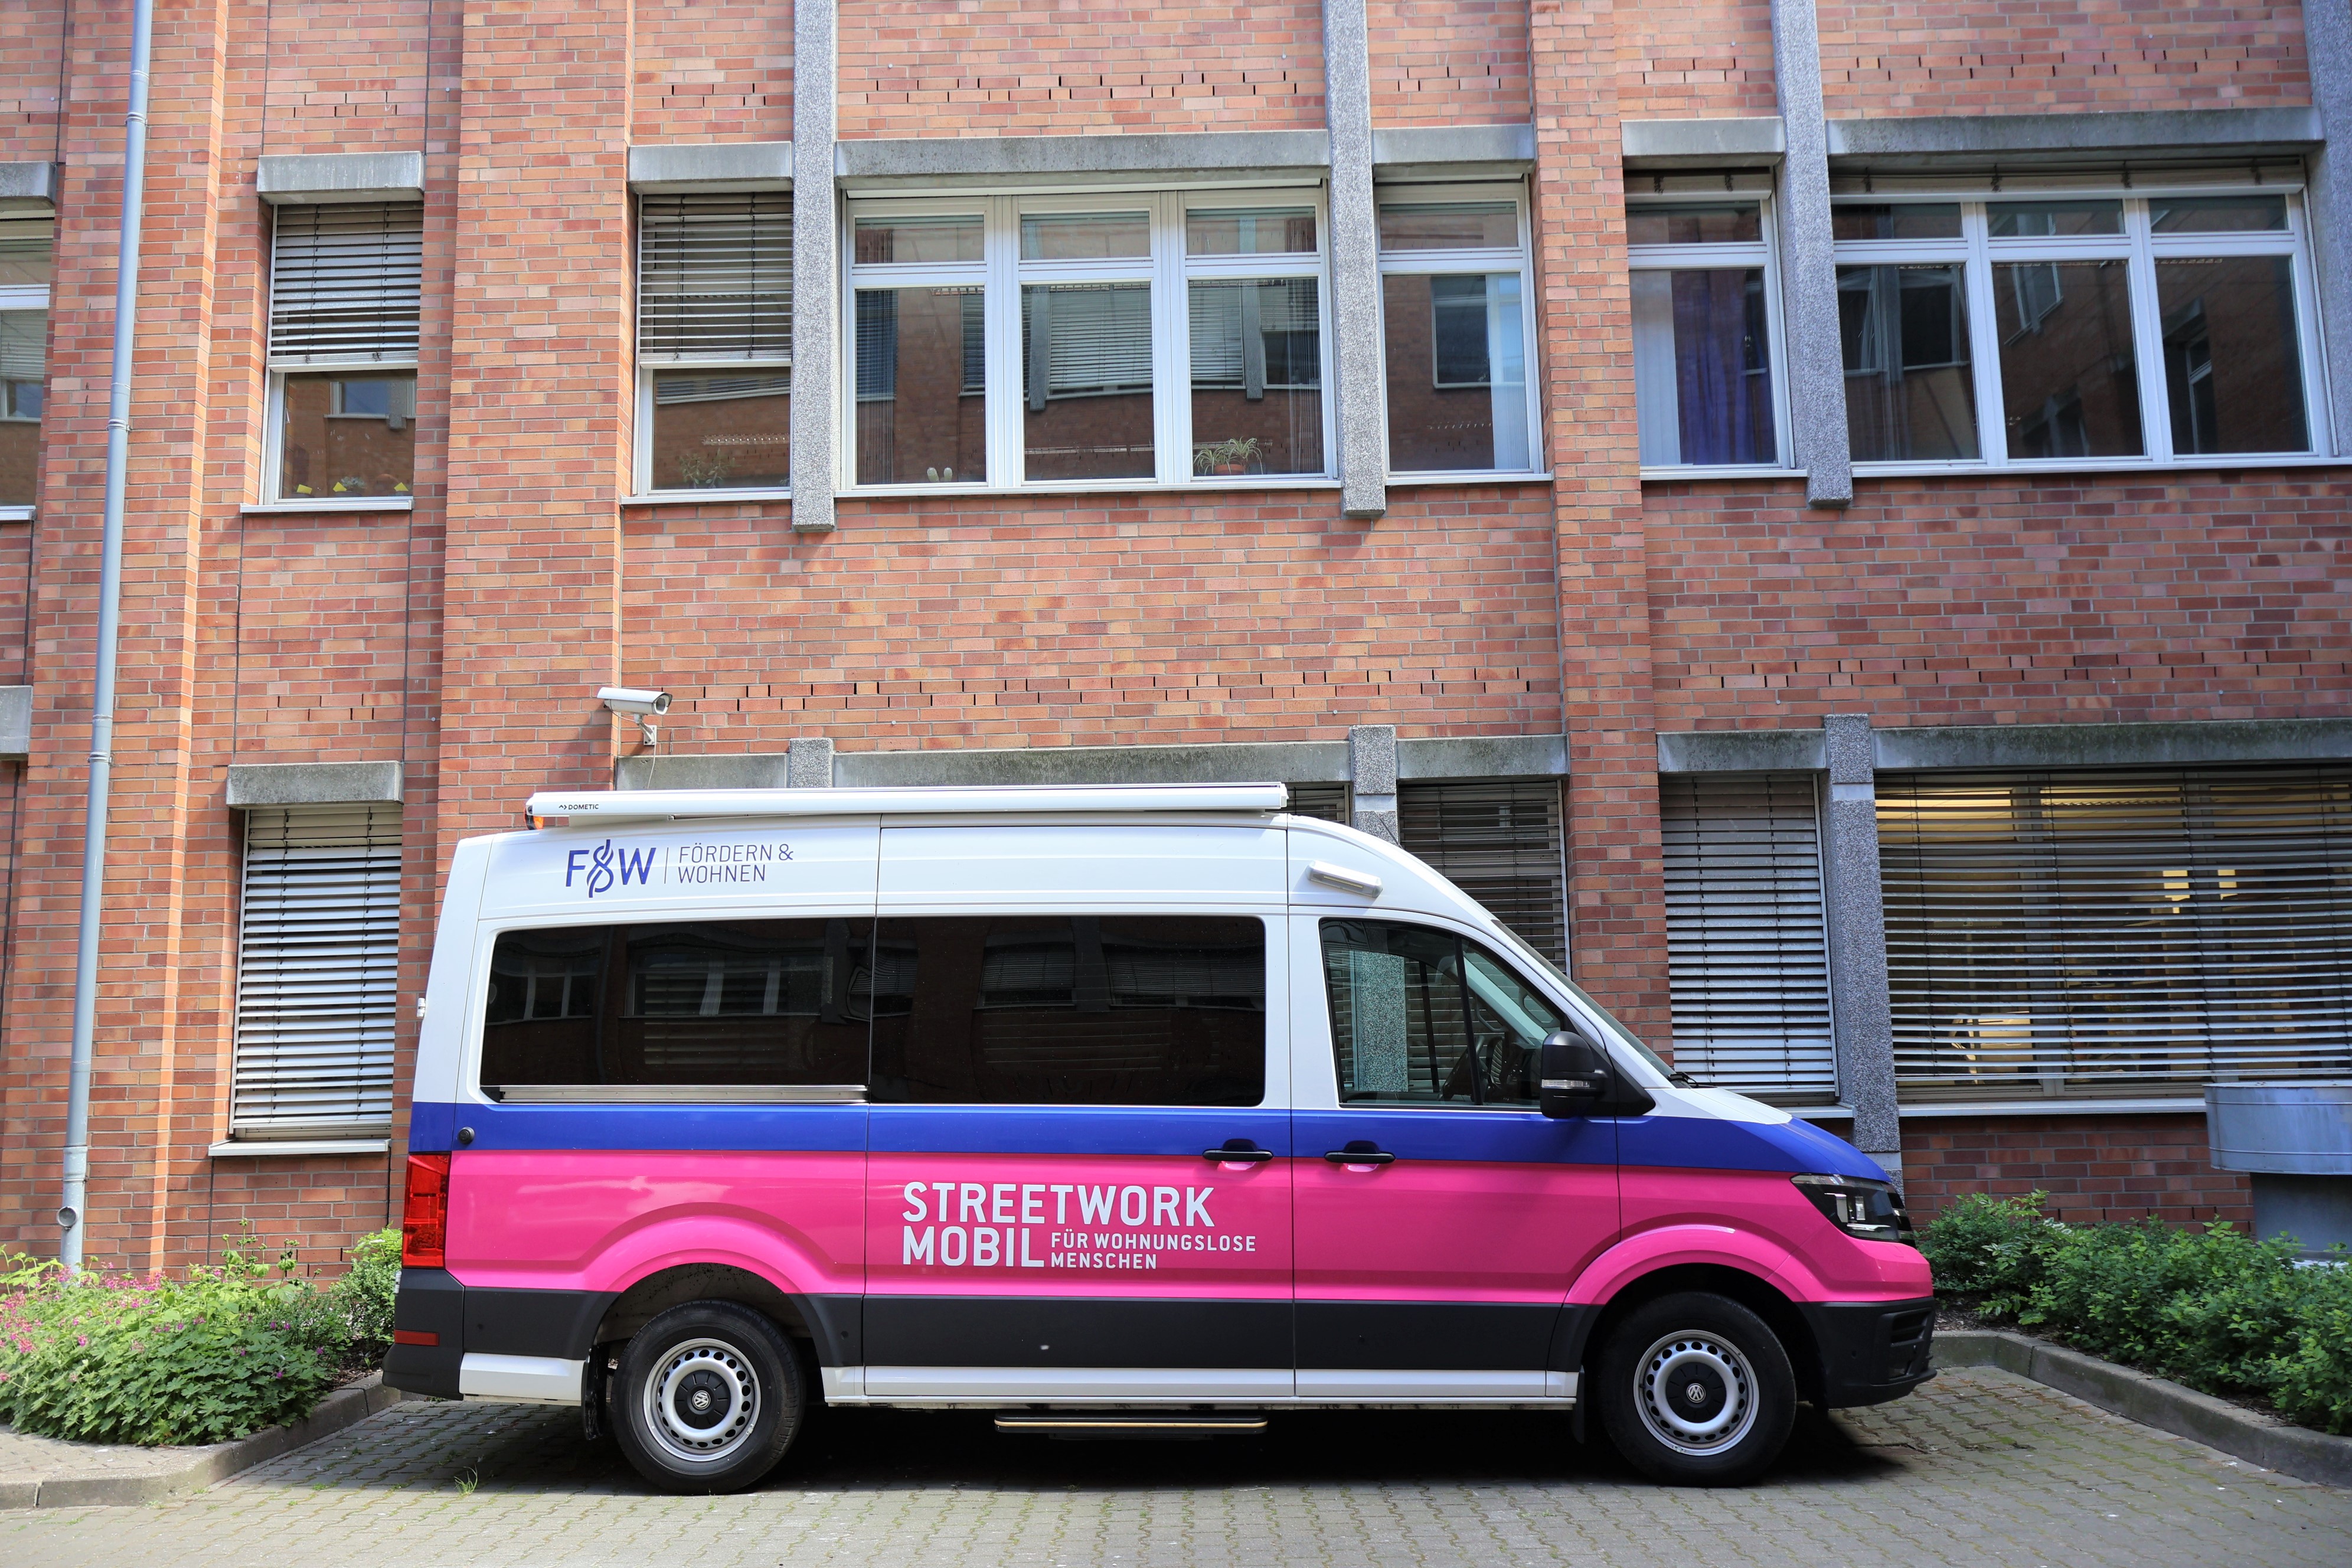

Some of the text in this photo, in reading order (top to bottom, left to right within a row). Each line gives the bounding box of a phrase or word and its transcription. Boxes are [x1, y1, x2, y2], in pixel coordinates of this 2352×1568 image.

[678, 842, 794, 864] FÖRDERN &
[678, 864, 766, 884] WOHNEN
[902, 1181, 1215, 1227] STREETWORK
[903, 1226, 1044, 1268] MOBIL
[1051, 1228, 1256, 1252] FÜR WOHNUNGSLOSE
[1051, 1252, 1157, 1269] MENSCHEN
